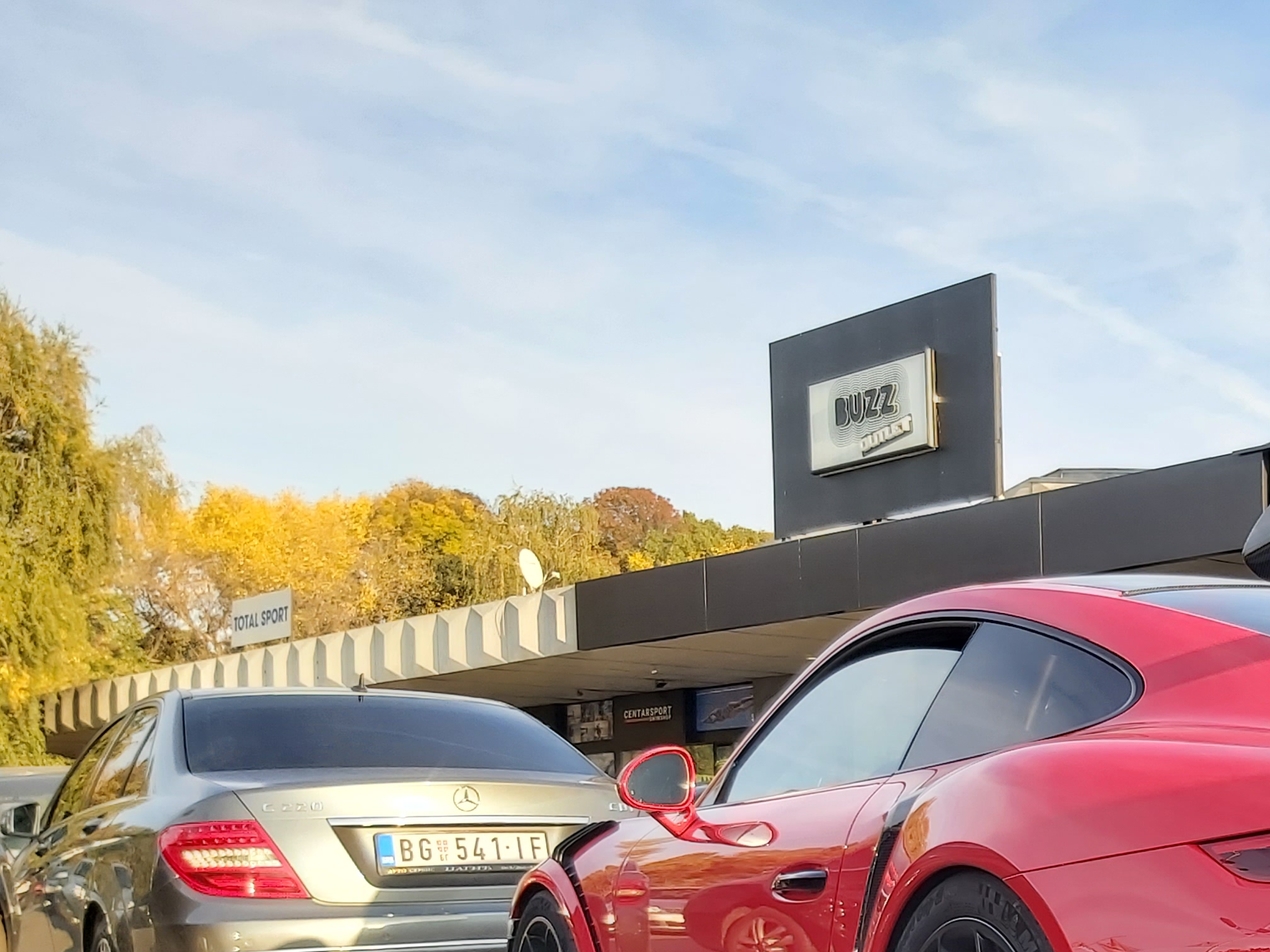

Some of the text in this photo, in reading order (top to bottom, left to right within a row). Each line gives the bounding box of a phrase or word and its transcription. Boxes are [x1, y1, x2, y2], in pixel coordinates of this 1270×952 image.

[835, 384, 899, 428] BUZZ
[861, 414, 912, 453] OUTLET
[234, 606, 289, 632] TOTAL SPORT
[623, 705, 673, 719] CENTARSPORT
[400, 838, 433, 862] BG
